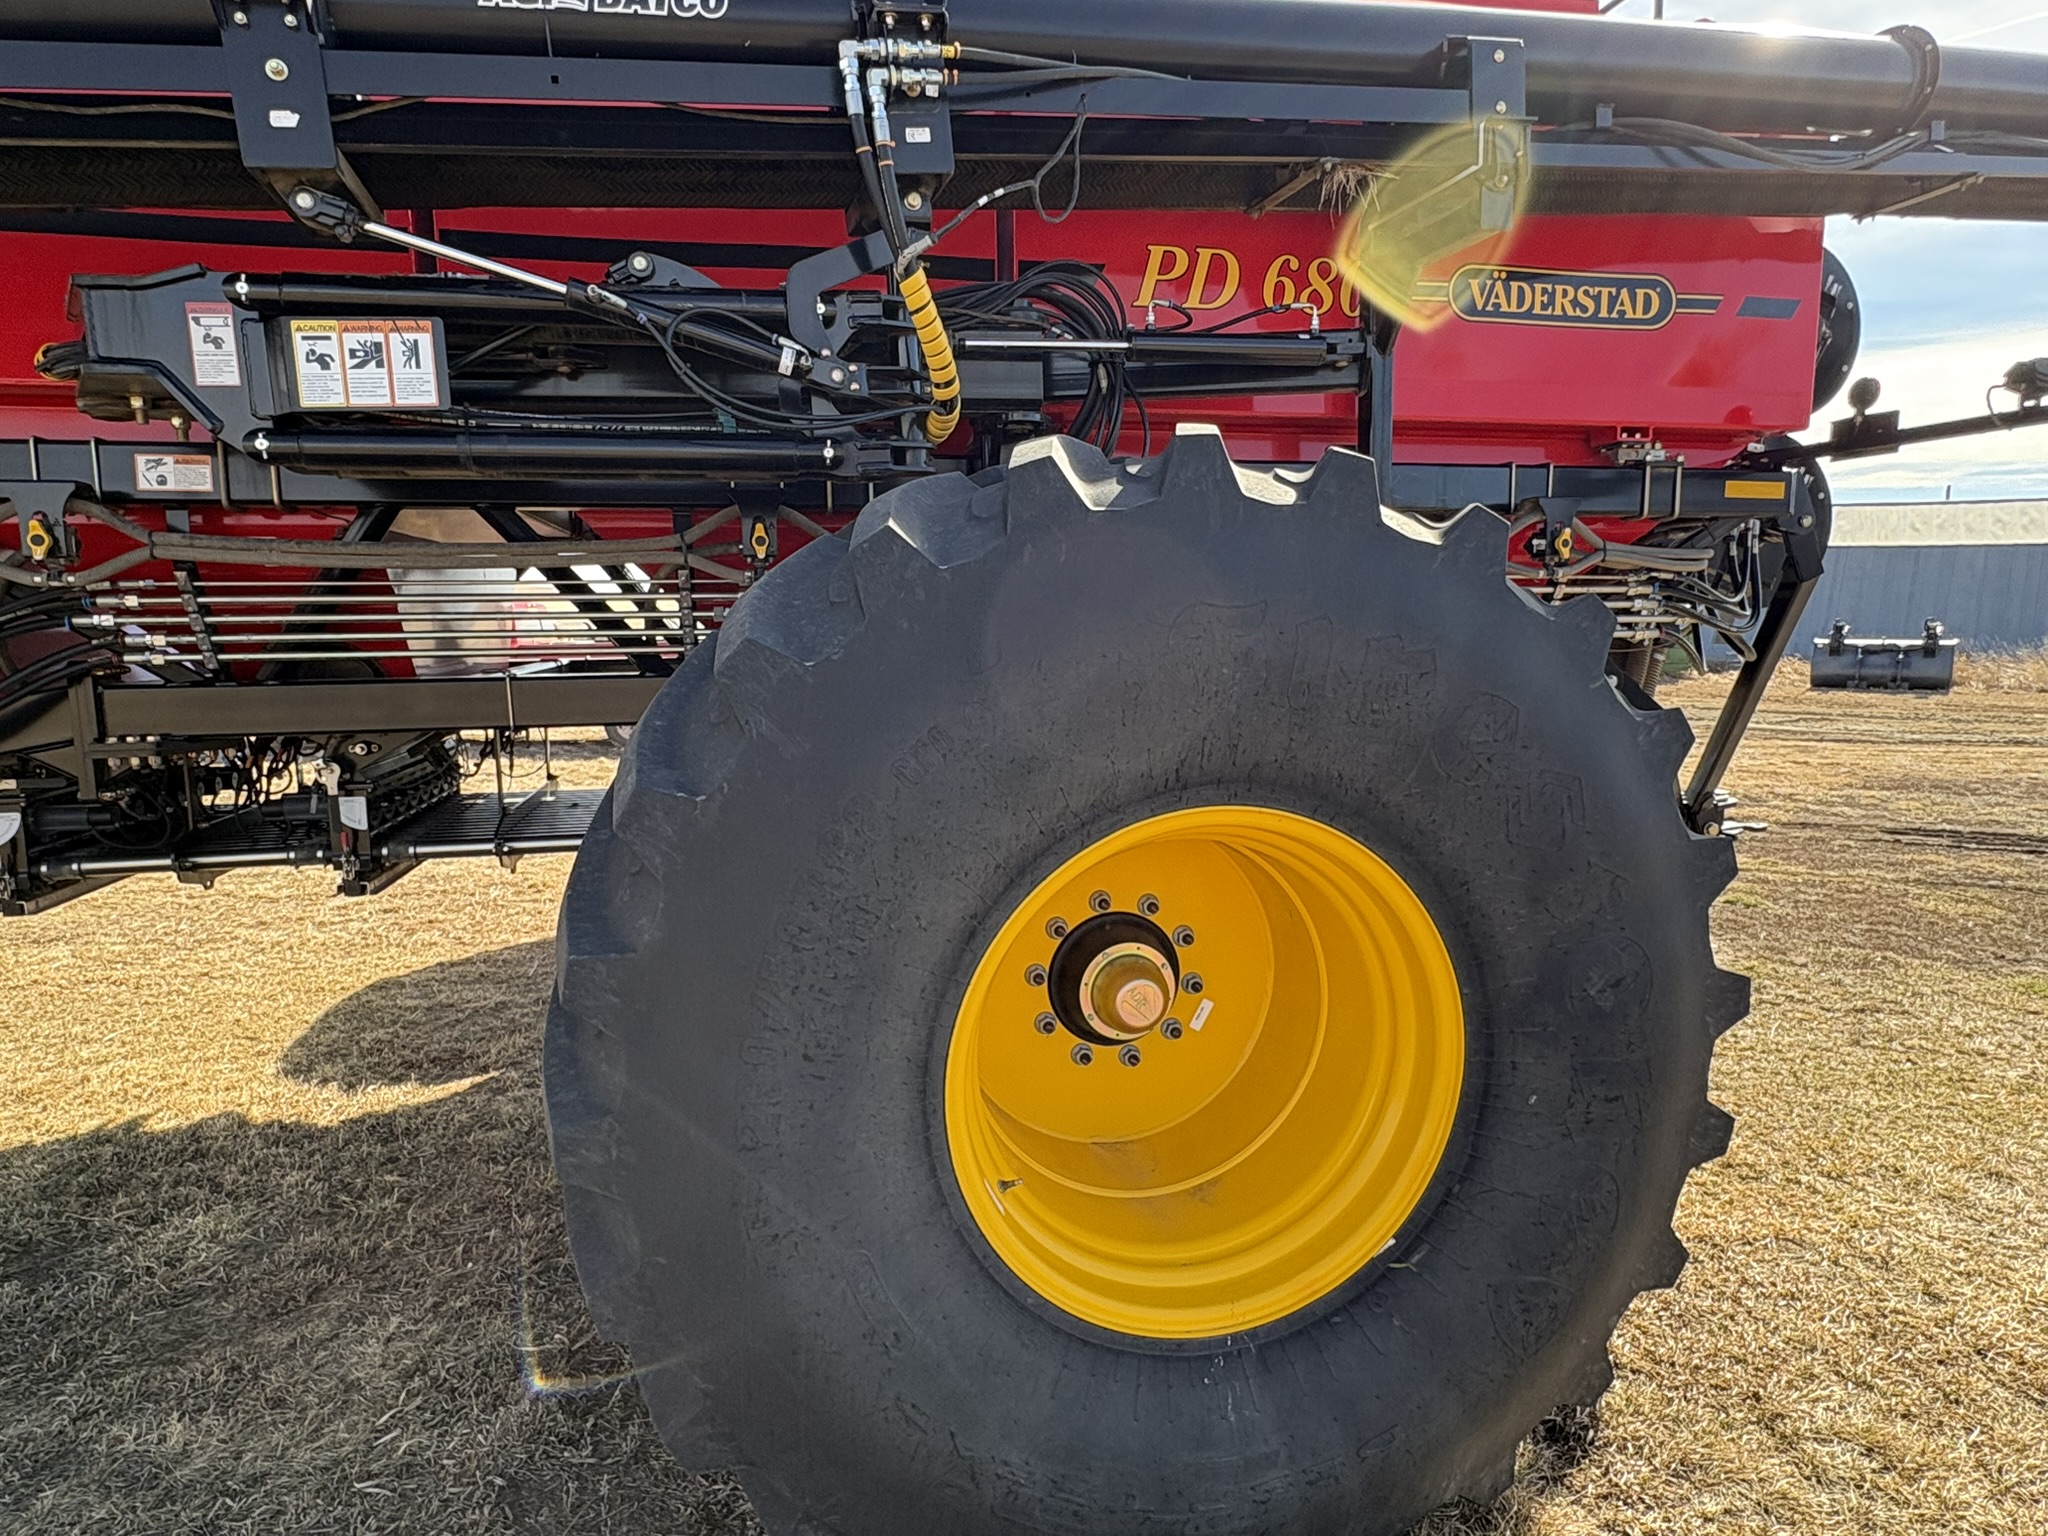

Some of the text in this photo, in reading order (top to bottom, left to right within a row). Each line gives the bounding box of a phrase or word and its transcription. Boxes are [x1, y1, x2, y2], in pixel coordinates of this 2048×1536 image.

[1133, 245, 1240, 310] PD
[1468, 271, 1660, 319] VÄDERSTAD
[303, 324, 336, 332] CAUTION
[350, 325, 384, 333] WARNING
[398, 325, 429, 333] WARNING
